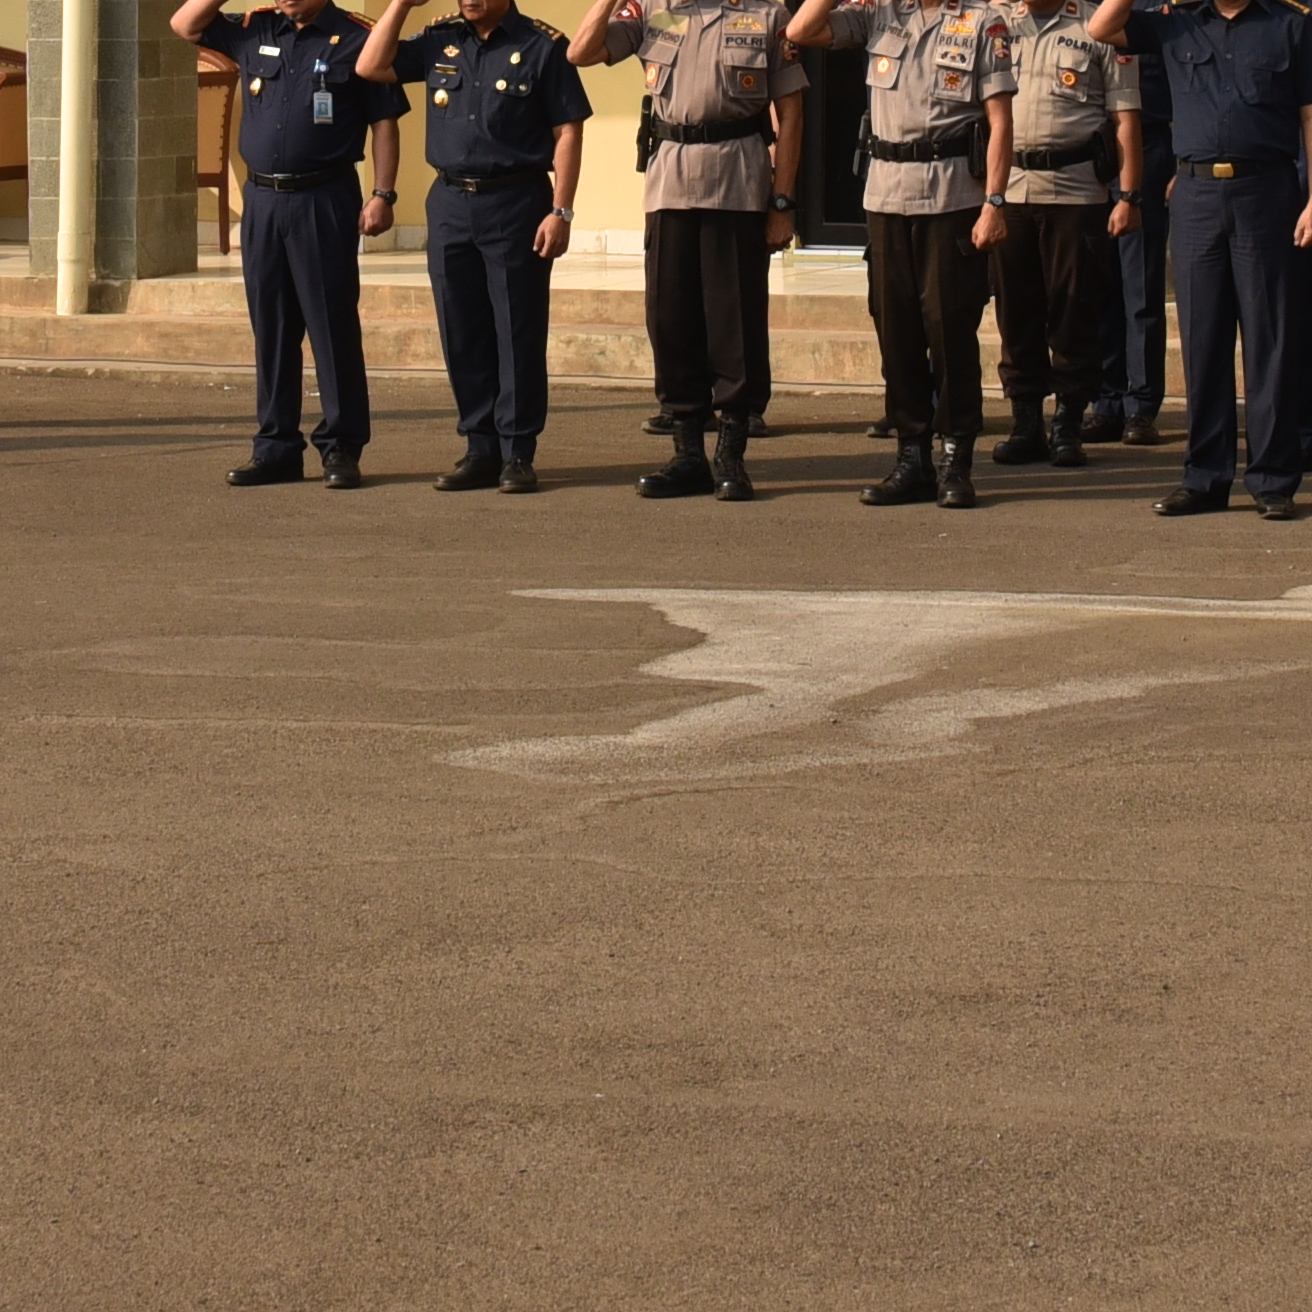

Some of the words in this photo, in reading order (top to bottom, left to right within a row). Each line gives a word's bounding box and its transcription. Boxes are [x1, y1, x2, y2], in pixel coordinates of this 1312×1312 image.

[725, 36, 763, 47] POLRI
[938, 35, 974, 49] POLRI
[1056, 35, 1093, 55] POLRI
